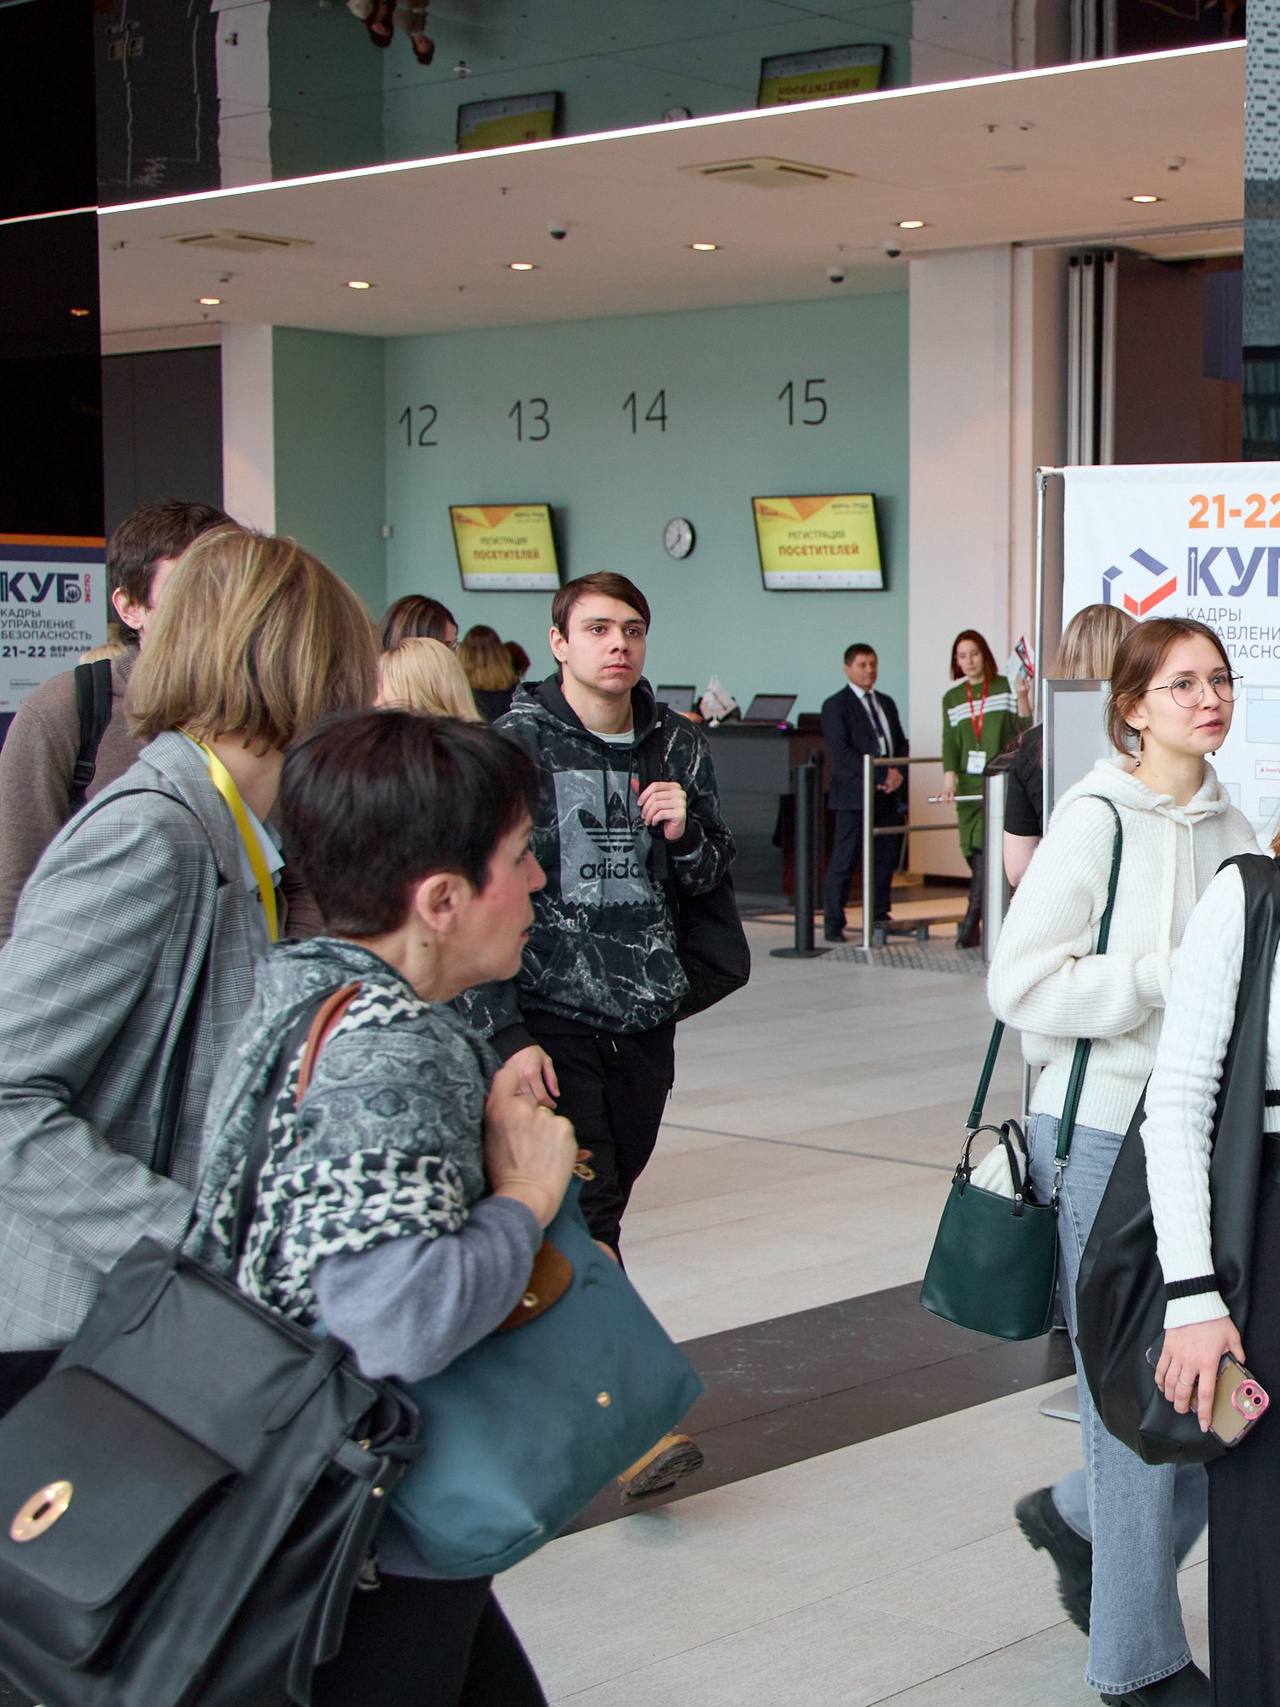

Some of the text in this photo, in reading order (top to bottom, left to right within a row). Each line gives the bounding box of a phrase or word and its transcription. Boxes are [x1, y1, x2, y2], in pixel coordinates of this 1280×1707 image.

[623, 389, 669, 434] 14
[779, 378, 828, 427] 15
[399, 404, 438, 447] 12
[508, 397, 550, 442] 13
[778, 541, 860, 557] ПОСЕТИТЕЛЕЙ
[0, 571, 82, 603] КУБ
[0, 608, 41, 618] КАДРЫ
[1186, 606, 1242, 624] КАДРЫ
[0, 620, 76, 630] УПРАВЛЕНИЕ
[0, 630, 92, 640] БЕЗОПАСНОСТЬ
[579, 858, 645, 880] adida
